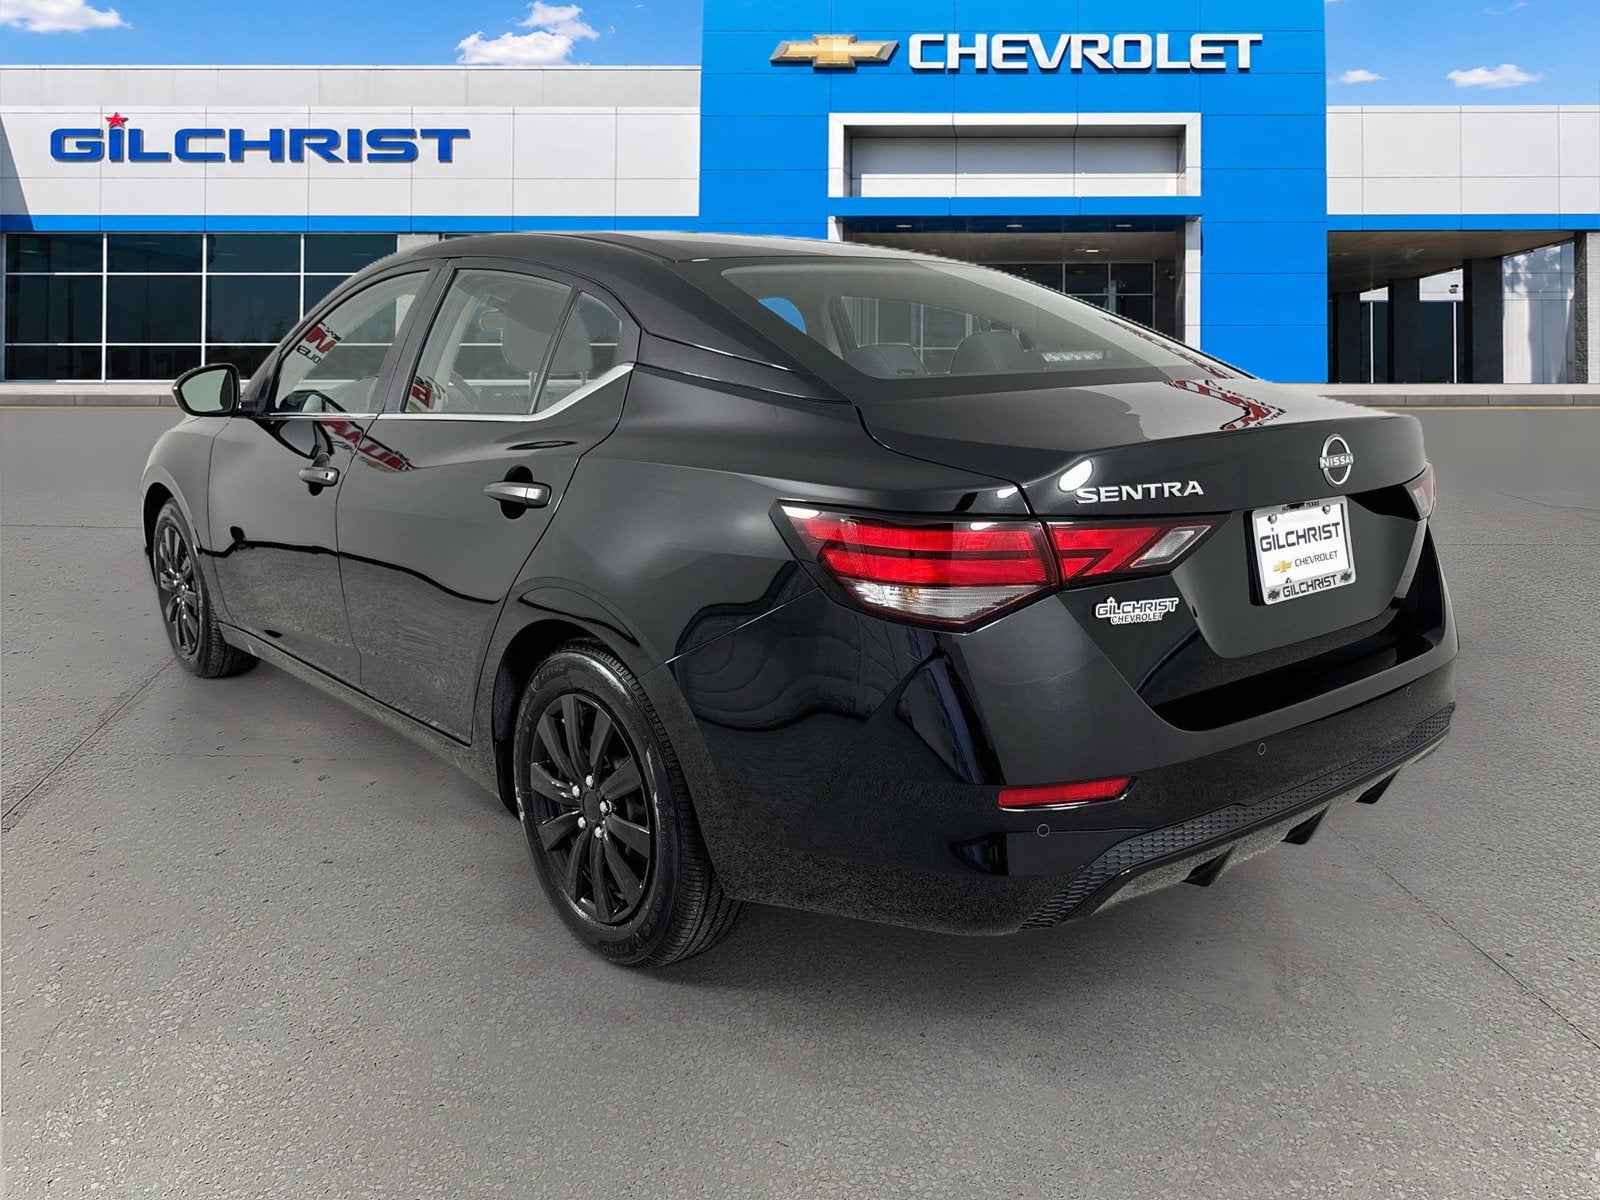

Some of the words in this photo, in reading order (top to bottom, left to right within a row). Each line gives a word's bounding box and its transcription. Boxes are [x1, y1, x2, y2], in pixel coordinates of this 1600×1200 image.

[908, 33, 1263, 71] CHEVROLET
[50, 113, 471, 163] GILCHRIST
[1320, 453, 1353, 469] NISSAN
[1075, 480, 1204, 504] SENTRA
[1259, 522, 1341, 552] GILCHRIST
[1294, 550, 1338, 567] CHEVROLET
[1282, 574, 1337, 598] GILCHRIST
[1095, 598, 1178, 617] GILCHRIST
[1111, 612, 1164, 625] CHEVROLET
